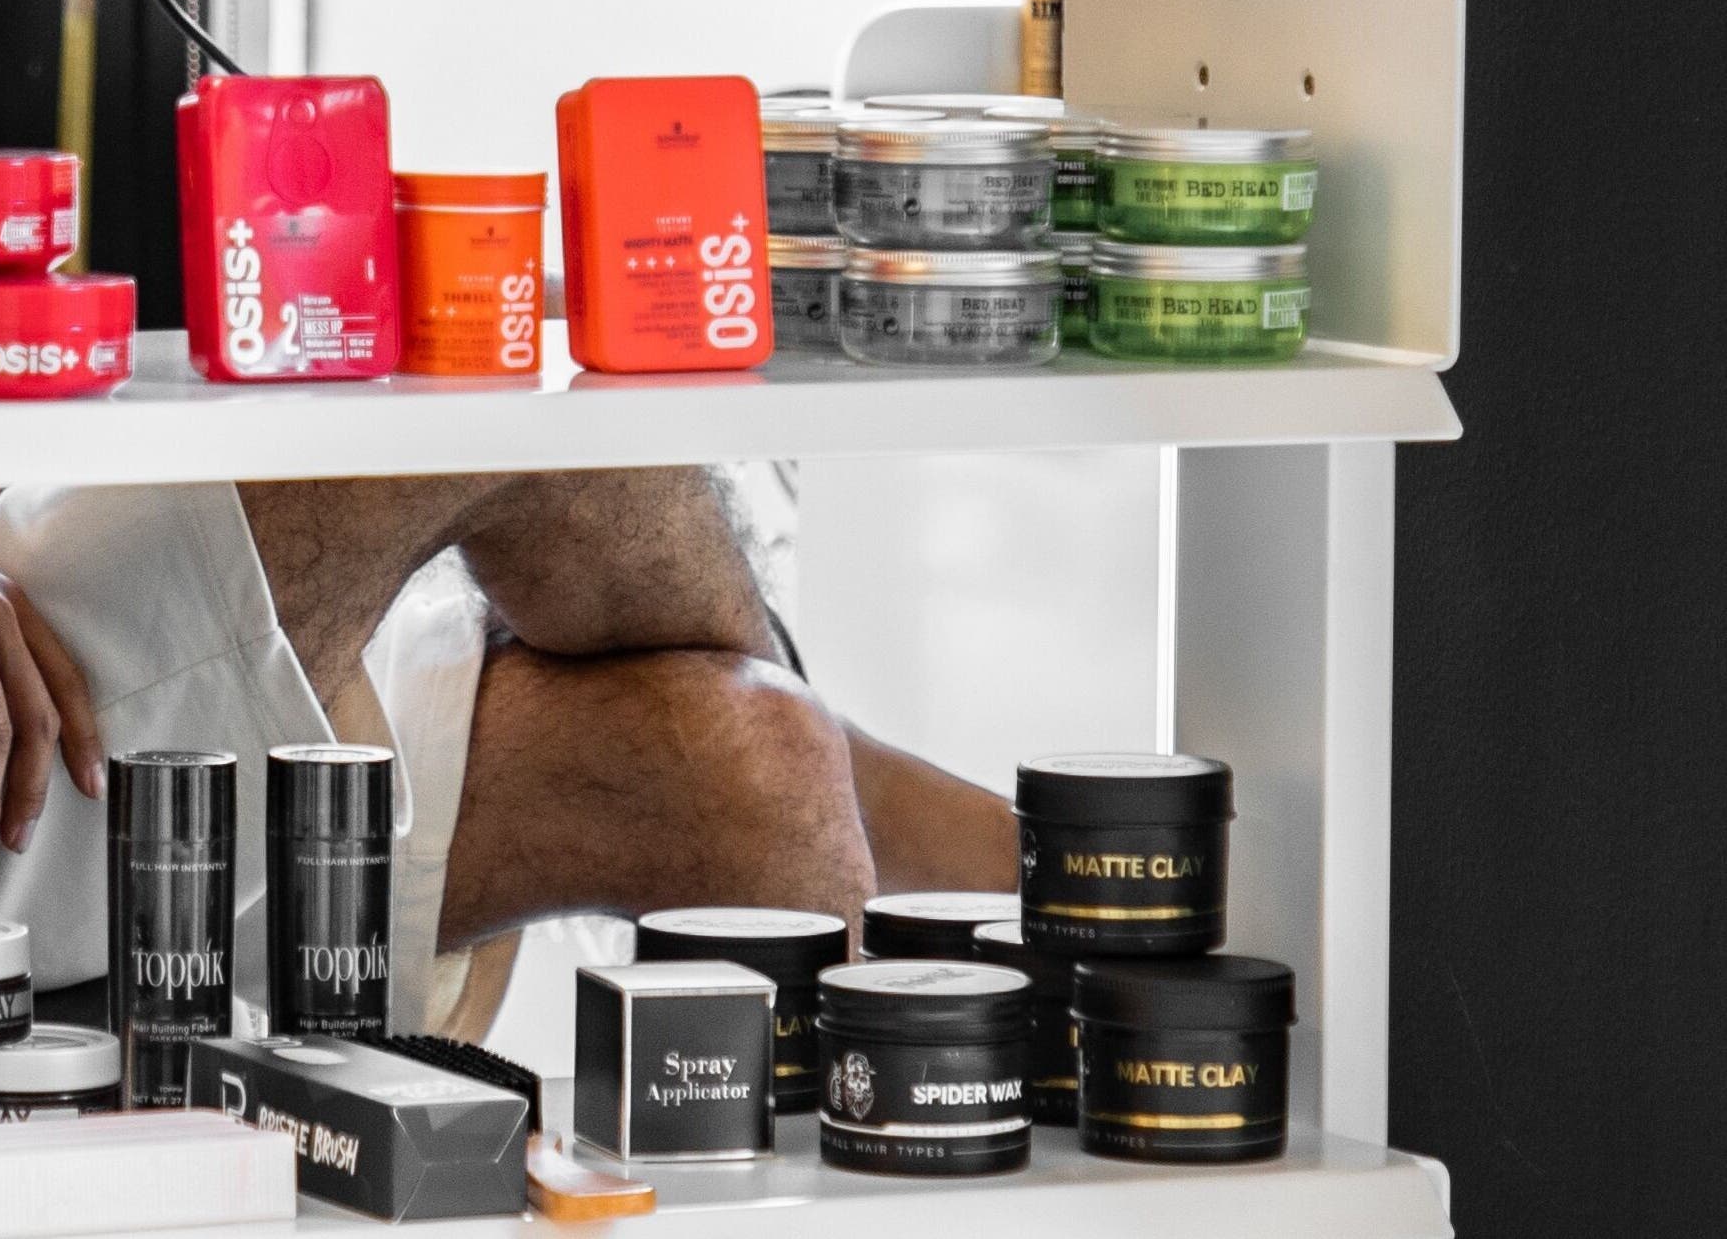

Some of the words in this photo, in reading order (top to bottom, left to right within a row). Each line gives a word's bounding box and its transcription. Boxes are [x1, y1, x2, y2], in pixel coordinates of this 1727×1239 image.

[1185, 179, 1226, 198] BED
[1231, 180, 1280, 198] HEAD
[961, 298, 990, 311] BED
[1163, 298, 1202, 316] BED
[1207, 297, 1258, 316] HEAD
[1065, 853, 1145, 878] MATTE
[1150, 853, 1205, 878] CLAY
[1055, 925, 1096, 939] TYPES
[665, 1051, 737, 1082] Spray
[1117, 1061, 1195, 1087] MATTE
[1199, 1062, 1260, 1087] CLAY
[645, 1081, 751, 1107] Applicator
[912, 1083, 988, 1105] SPIDER
[990, 1080, 1023, 1102] WAX
[313, 1122, 359, 1176] BRUSH
[856, 1143, 888, 1156] HAIR
[897, 1145, 945, 1158] TYPES
